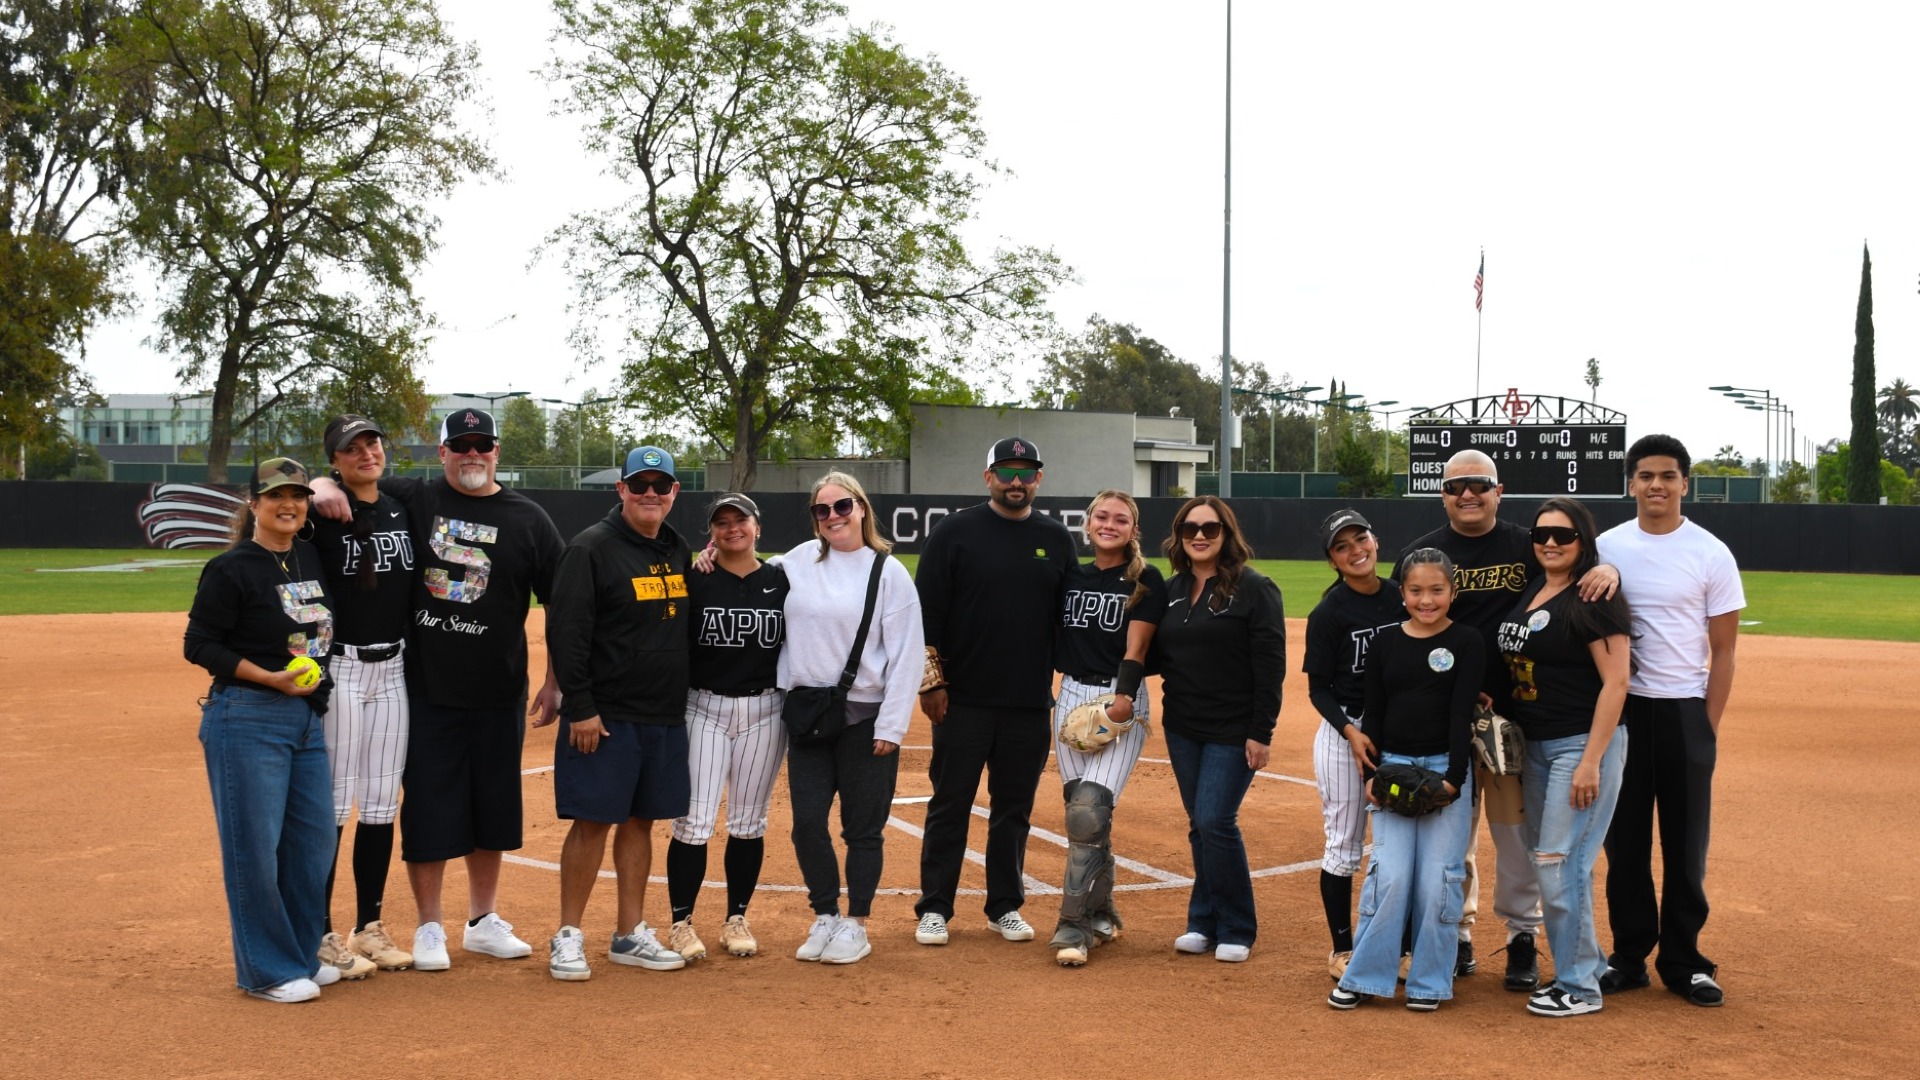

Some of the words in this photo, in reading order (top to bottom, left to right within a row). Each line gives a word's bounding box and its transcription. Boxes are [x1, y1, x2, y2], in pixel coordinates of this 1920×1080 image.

[1413, 433, 1438, 444] BALL
[1441, 430, 1451, 447] 0
[1470, 433, 1505, 444] STRIKE
[1506, 430, 1517, 447] 0
[1539, 433, 1560, 444] OUT
[1560, 429, 1571, 447] 0
[1590, 433, 1608, 445] H/E
[1492, 451, 1498, 459] 4
[1503, 451, 1510, 460] 5
[1515, 451, 1522, 460] 6
[1530, 451, 1536, 460] 7
[1541, 451, 1548, 460] 8
[1556, 451, 1577, 460] RUNS
[1585, 451, 1604, 460] HITS
[1567, 460, 1577, 475] 0
[1567, 478, 1577, 492] 0
[1452, 563, 1528, 599] AKERS
[1063, 590, 1130, 632] APU
[415, 609, 442, 627] Our
[442, 614, 489, 636] Senior
[699, 607, 783, 649] APU
